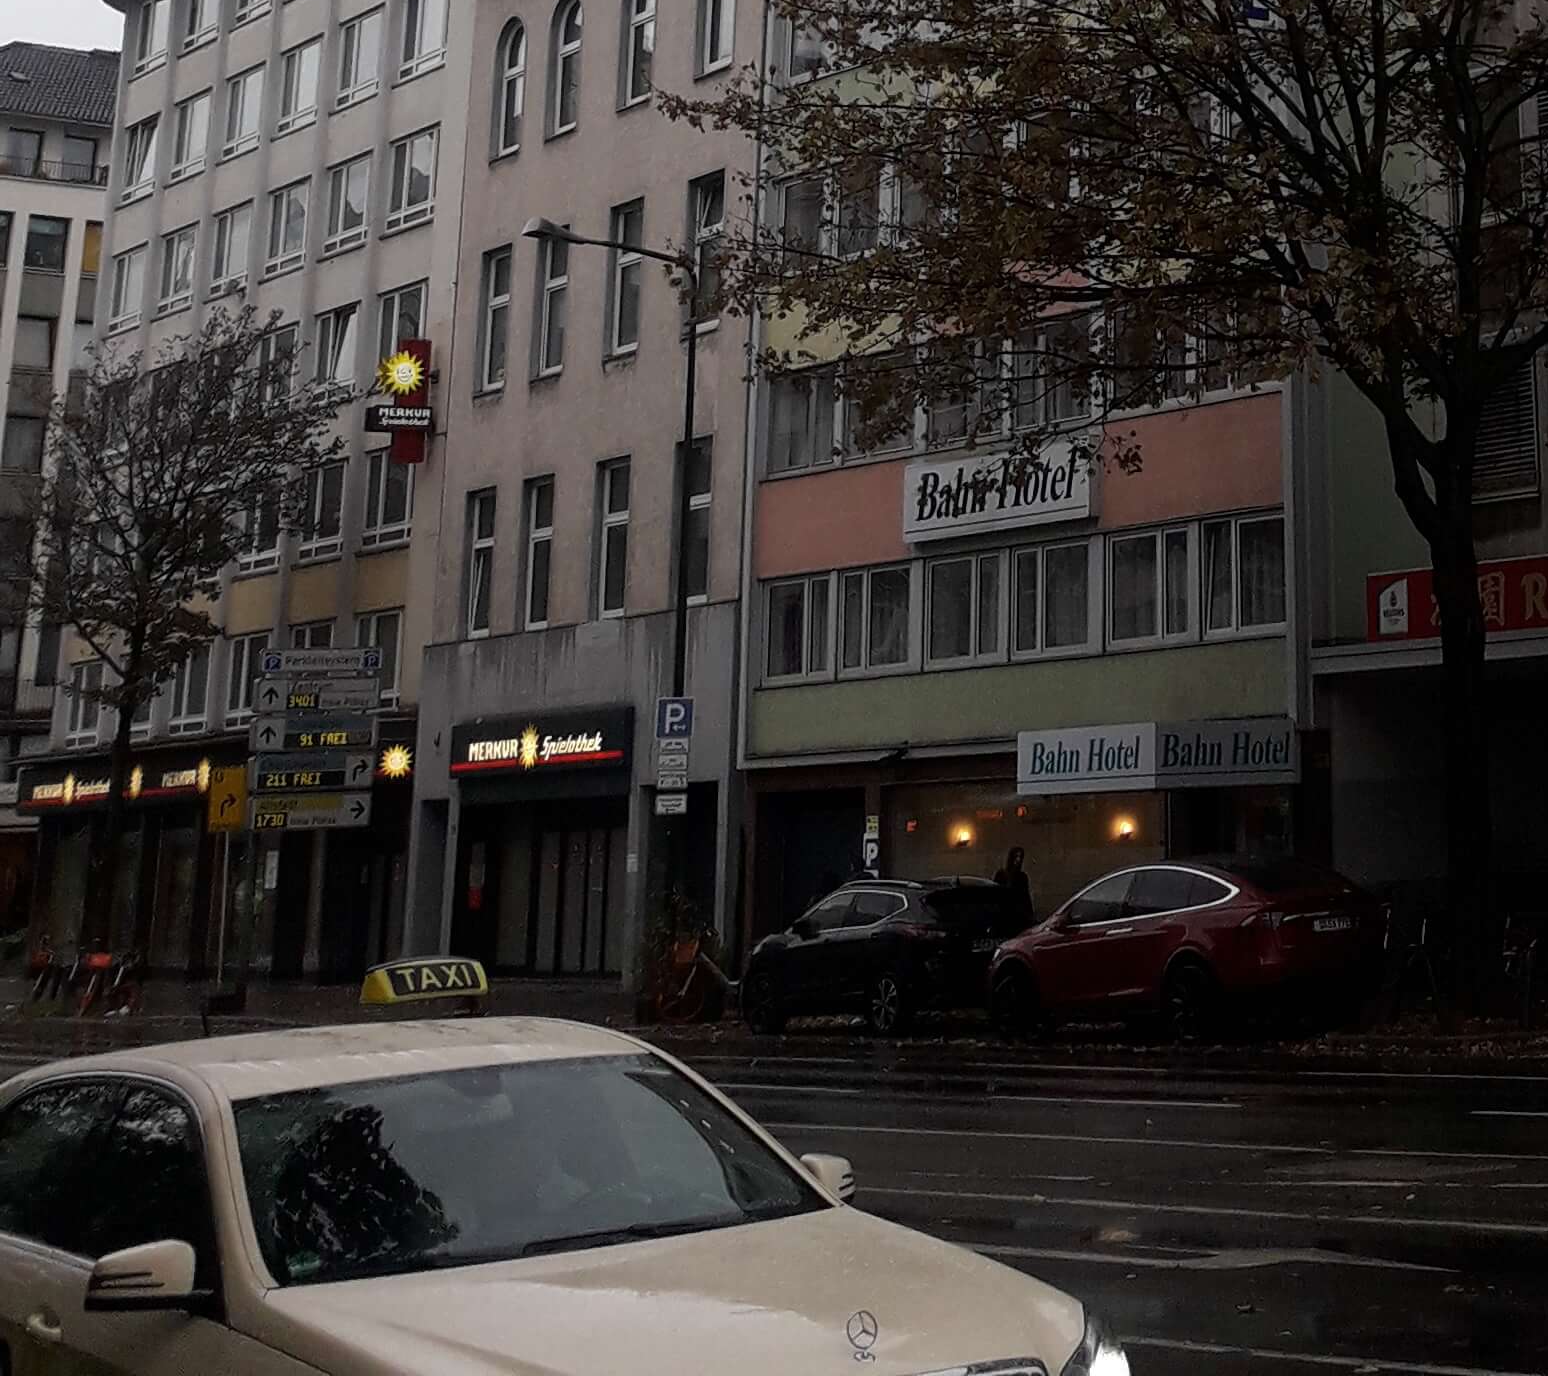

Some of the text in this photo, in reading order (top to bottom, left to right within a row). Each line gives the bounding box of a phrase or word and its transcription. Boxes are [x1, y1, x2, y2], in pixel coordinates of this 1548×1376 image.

[379, 407, 431, 418] MERKUR
[915, 446, 1079, 522] Bahn Hotel
[287, 694, 316, 708] 3401
[299, 731, 347, 747] 91 FREI
[468, 731, 603, 762] MERKUR Spielothek
[1161, 732, 1291, 768] Bahn Hotel
[1031, 736, 1140, 776] Bahn Hotel
[265, 772, 322, 787] 211 FREI
[256, 814, 285, 828] 1730
[395, 964, 473, 992] TAXI
